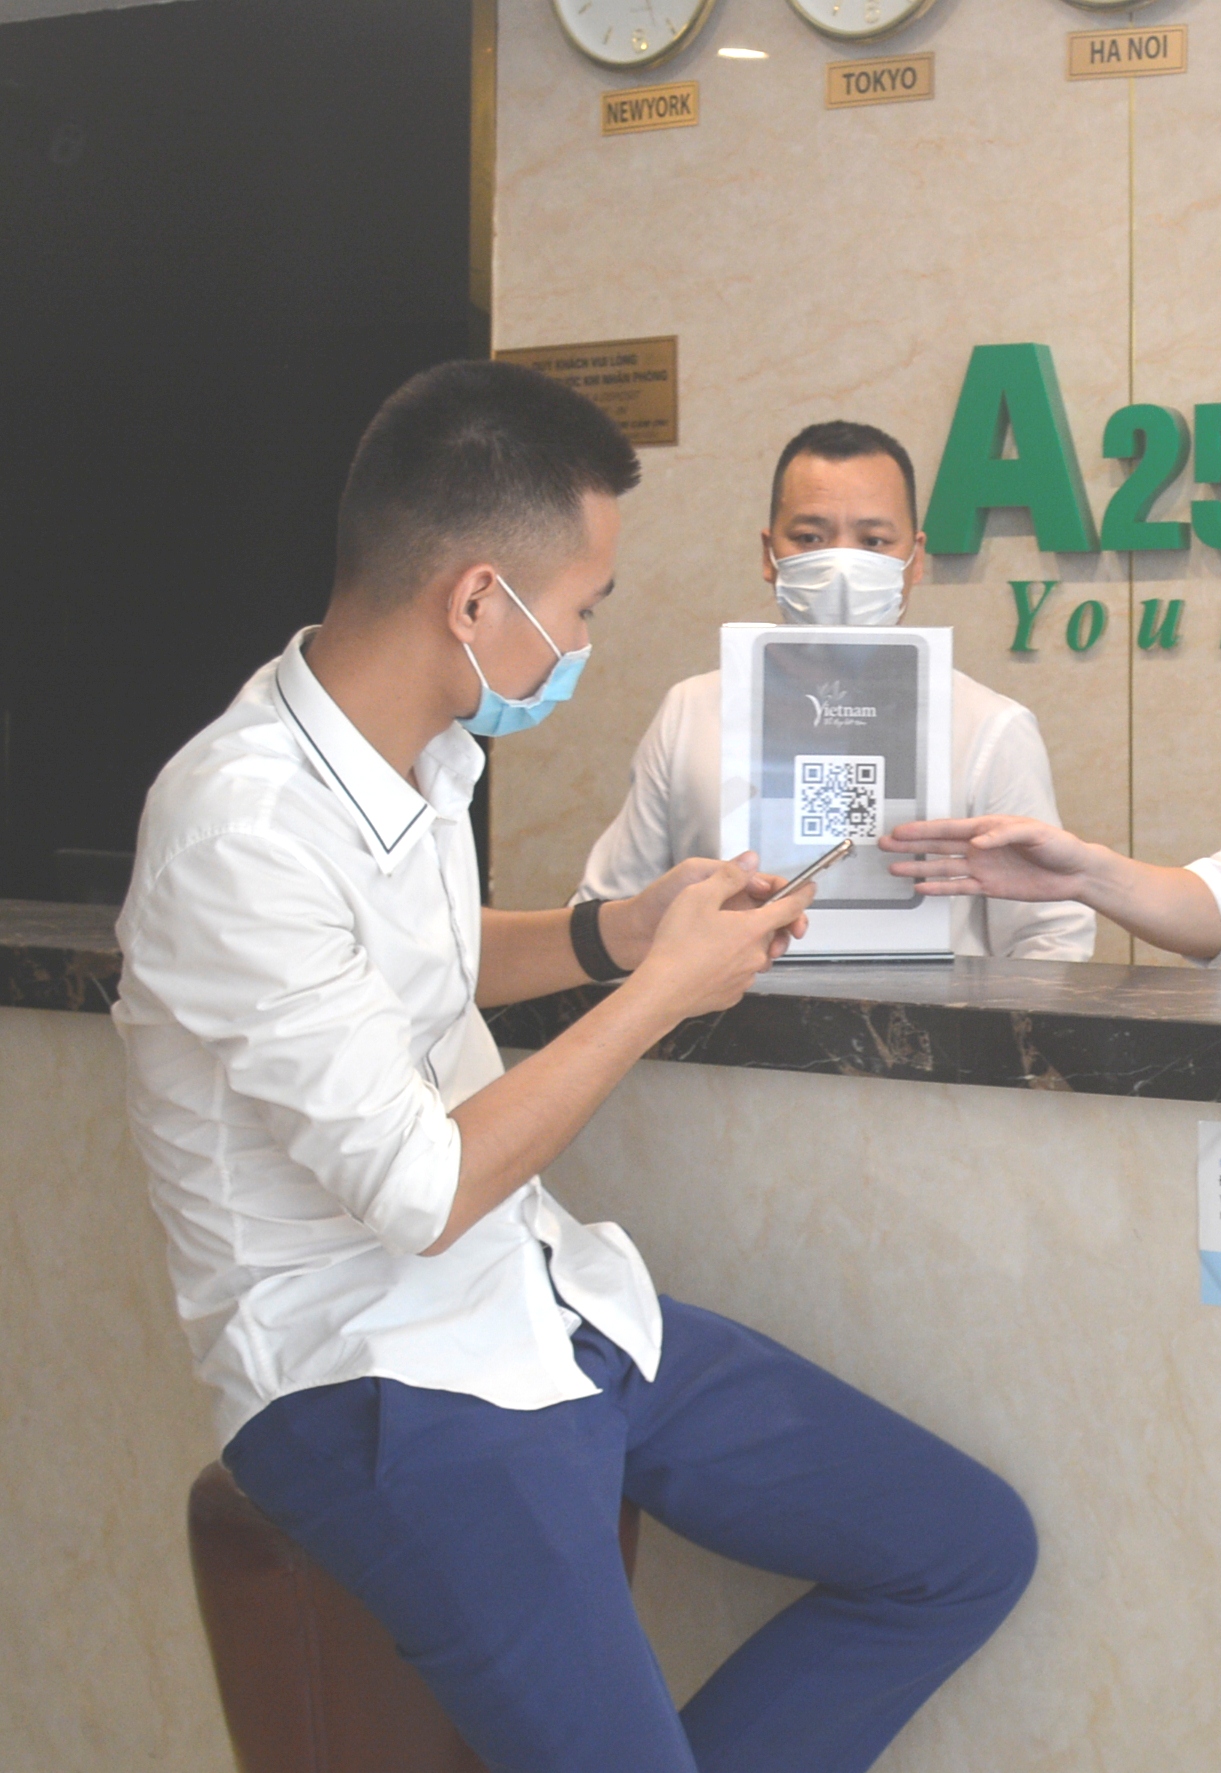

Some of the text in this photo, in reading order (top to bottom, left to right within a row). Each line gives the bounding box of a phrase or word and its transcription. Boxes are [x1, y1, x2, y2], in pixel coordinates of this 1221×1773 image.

[1089, 34, 1167, 64] HA NOI
[842, 66, 917, 96] TOKYO
[606, 93, 691, 125] NEWYORK
[804, 694, 877, 727] Vietnam
